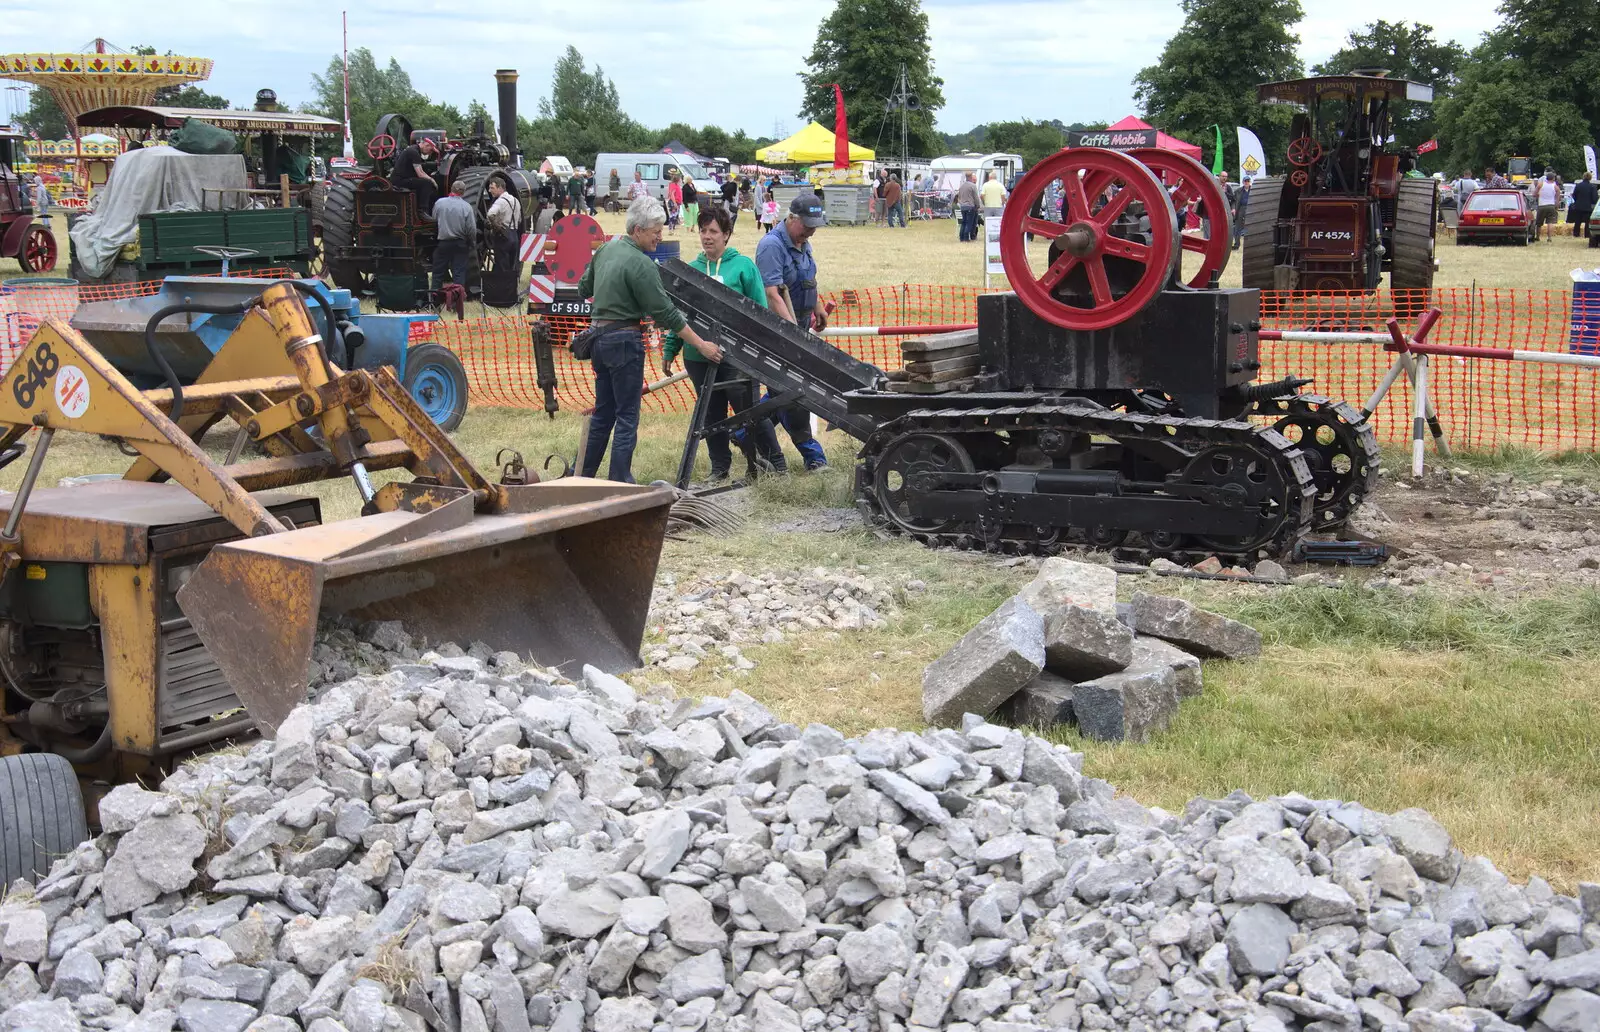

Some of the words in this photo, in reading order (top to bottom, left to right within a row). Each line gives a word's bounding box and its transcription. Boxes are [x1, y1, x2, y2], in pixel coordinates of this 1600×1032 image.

[222, 120, 239, 128] SONS
[246, 120, 287, 129] AMUSEMENTS
[293, 123, 324, 131] WHITWELL
[1110, 133, 1147, 146] Mobile
[1311, 231, 1324, 239] AF
[1325, 231, 1351, 240] 4574
[551, 303, 564, 313] CF
[566, 303, 591, 313] 5913
[13, 342, 59, 409] 648
